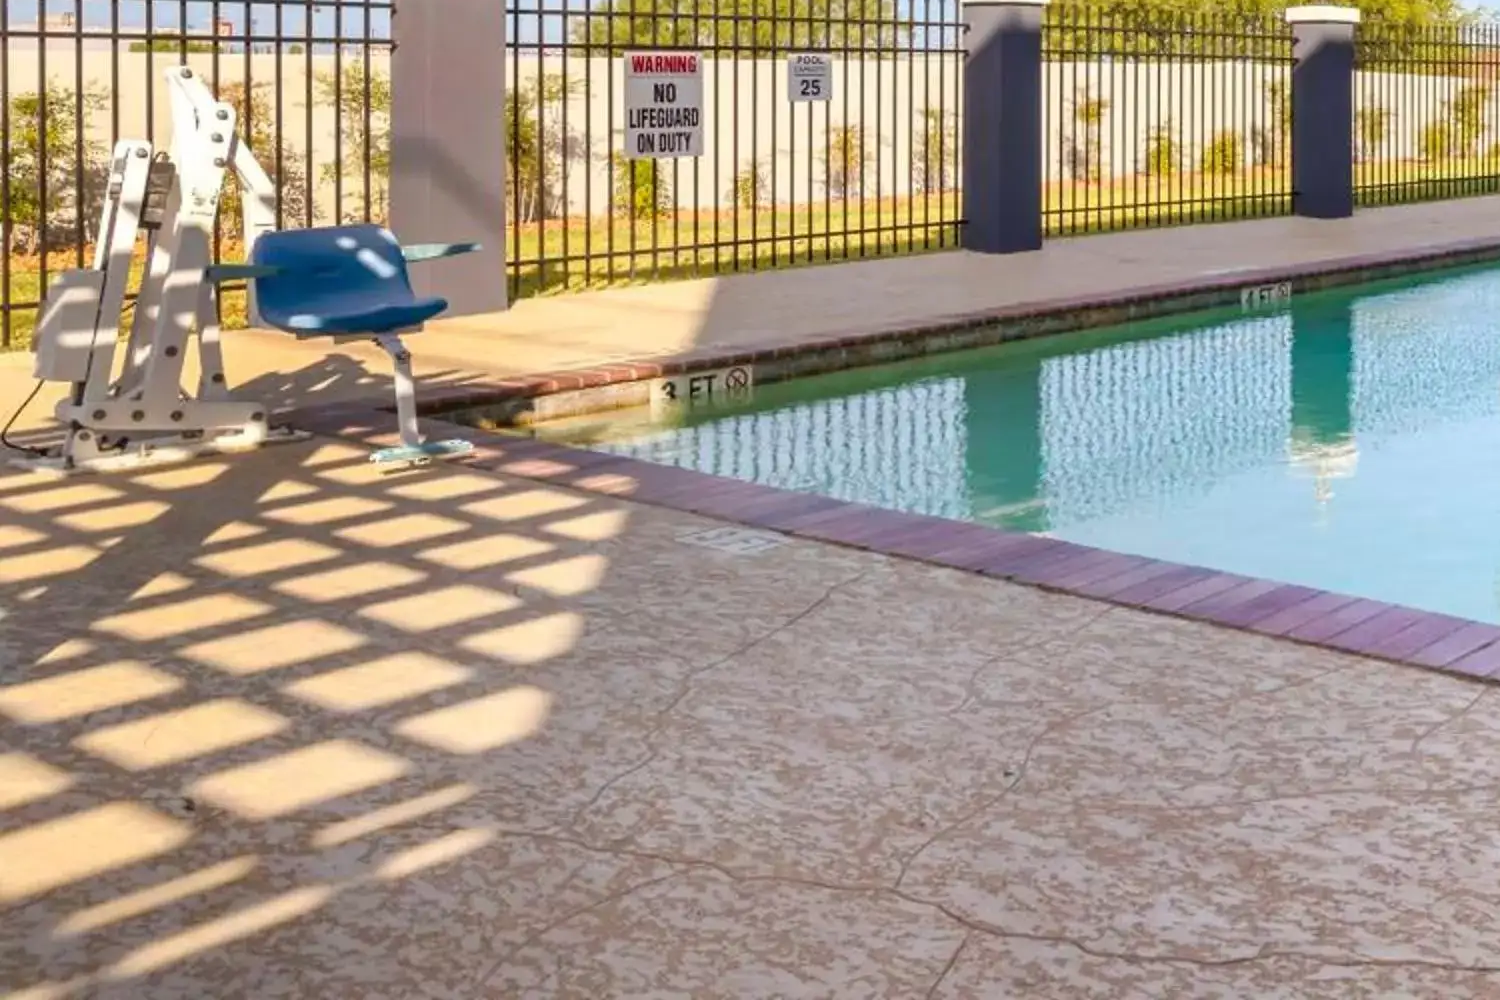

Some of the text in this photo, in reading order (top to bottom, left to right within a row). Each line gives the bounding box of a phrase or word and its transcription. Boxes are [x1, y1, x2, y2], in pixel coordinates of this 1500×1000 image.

[631, 55, 697, 73] WARNING
[797, 55, 825, 65] POOL
[653, 82, 676, 103] NO
[800, 79, 821, 96] 25
[629, 107, 699, 128] LIFEGUARD
[637, 132, 692, 153] ON DUTY
[689, 374, 718, 398] FT
